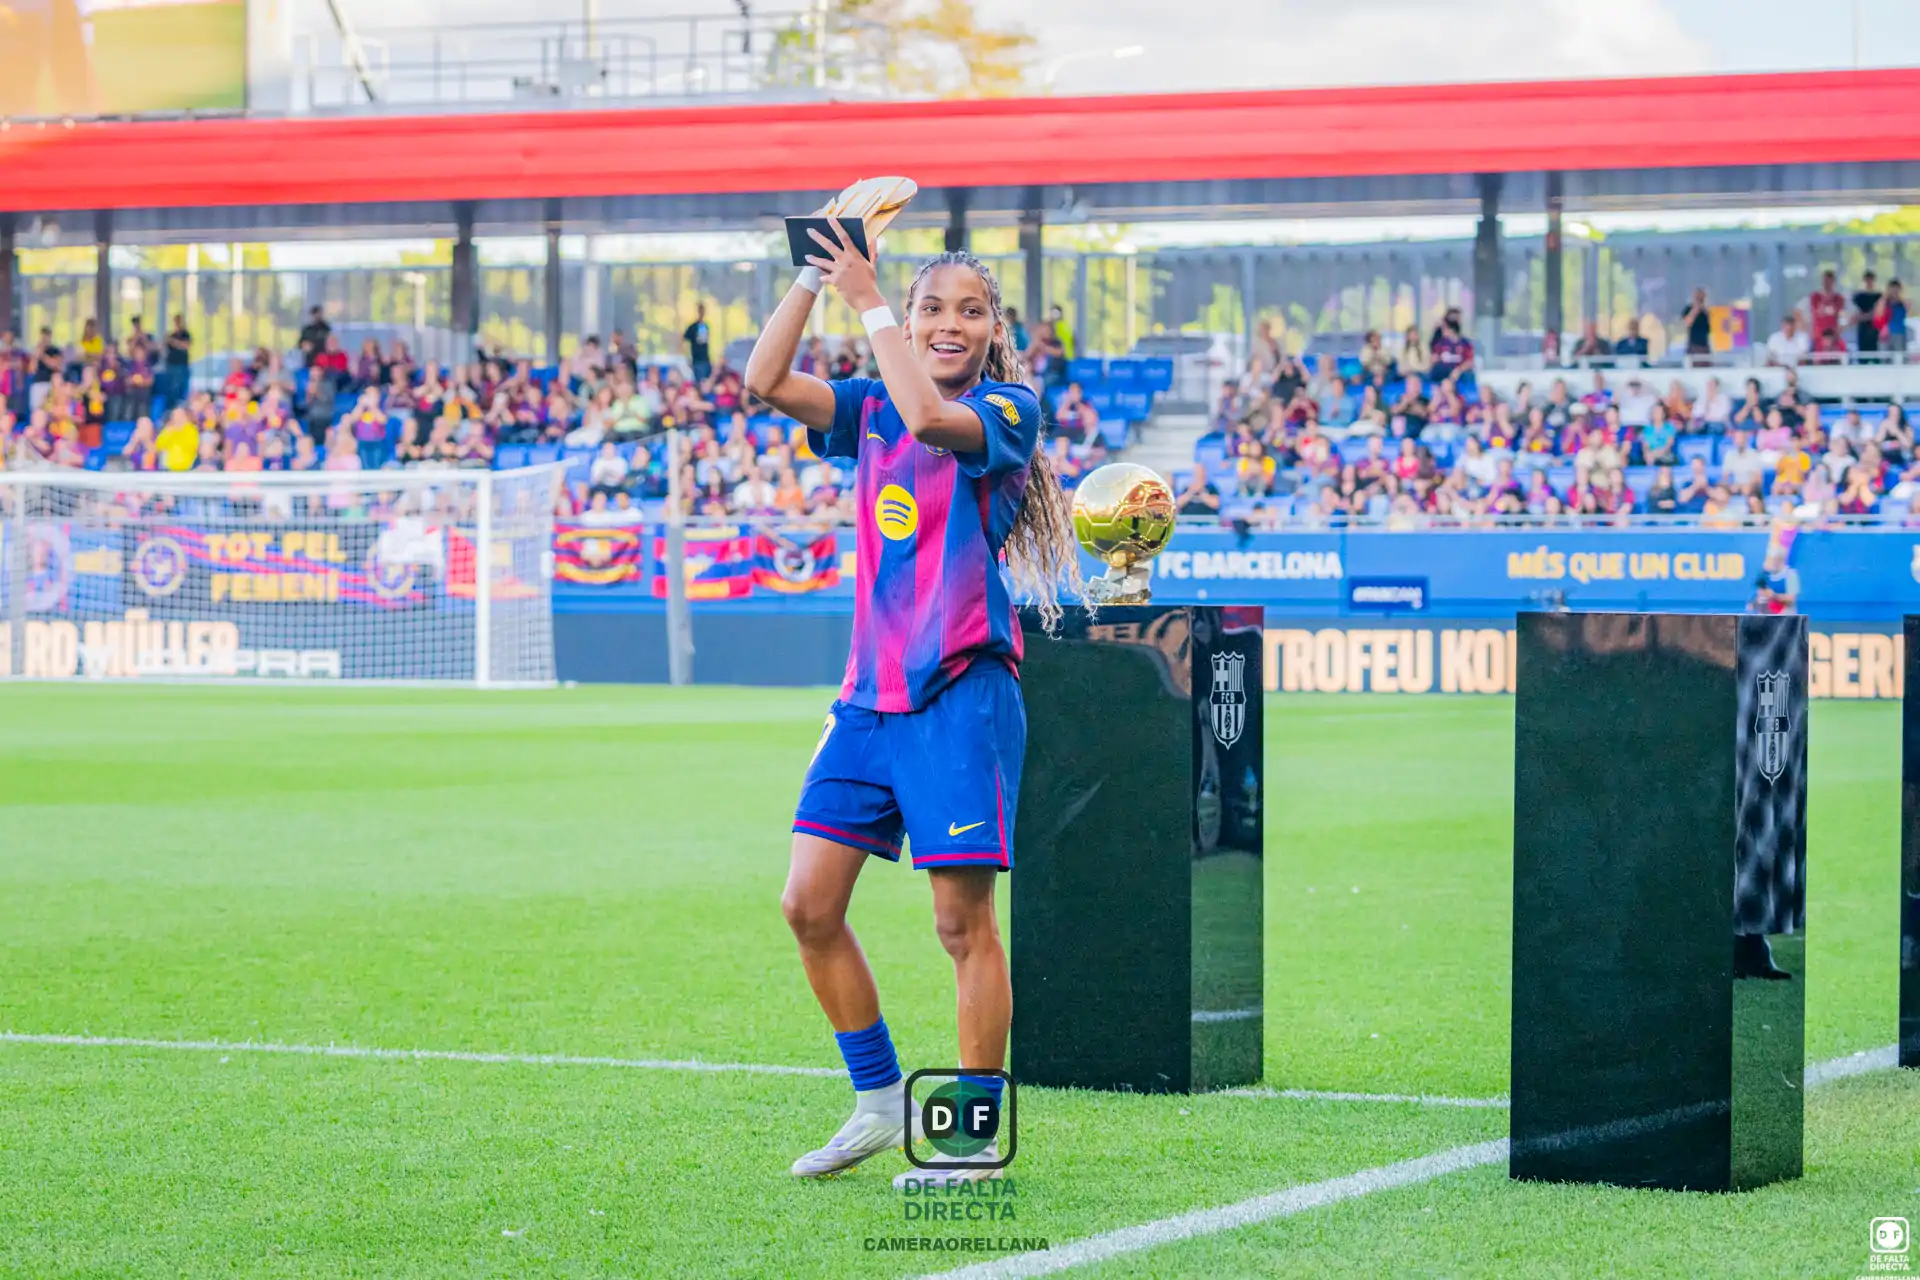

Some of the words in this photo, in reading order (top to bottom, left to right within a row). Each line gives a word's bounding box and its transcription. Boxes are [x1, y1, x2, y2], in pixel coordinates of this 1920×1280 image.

[202, 532, 273, 562] TOT
[282, 531, 347, 563] PEL
[1158, 551, 1191, 579] FC
[1192, 551, 1343, 579] BARCELONA
[1507, 545, 1566, 579] MÉS
[1569, 552, 1625, 584] QUE
[1629, 552, 1670, 580] UN
[1673, 552, 1745, 580] CLUB
[1263, 628, 1433, 693] TROFEU
[1221, 692, 1236, 704] FCB
